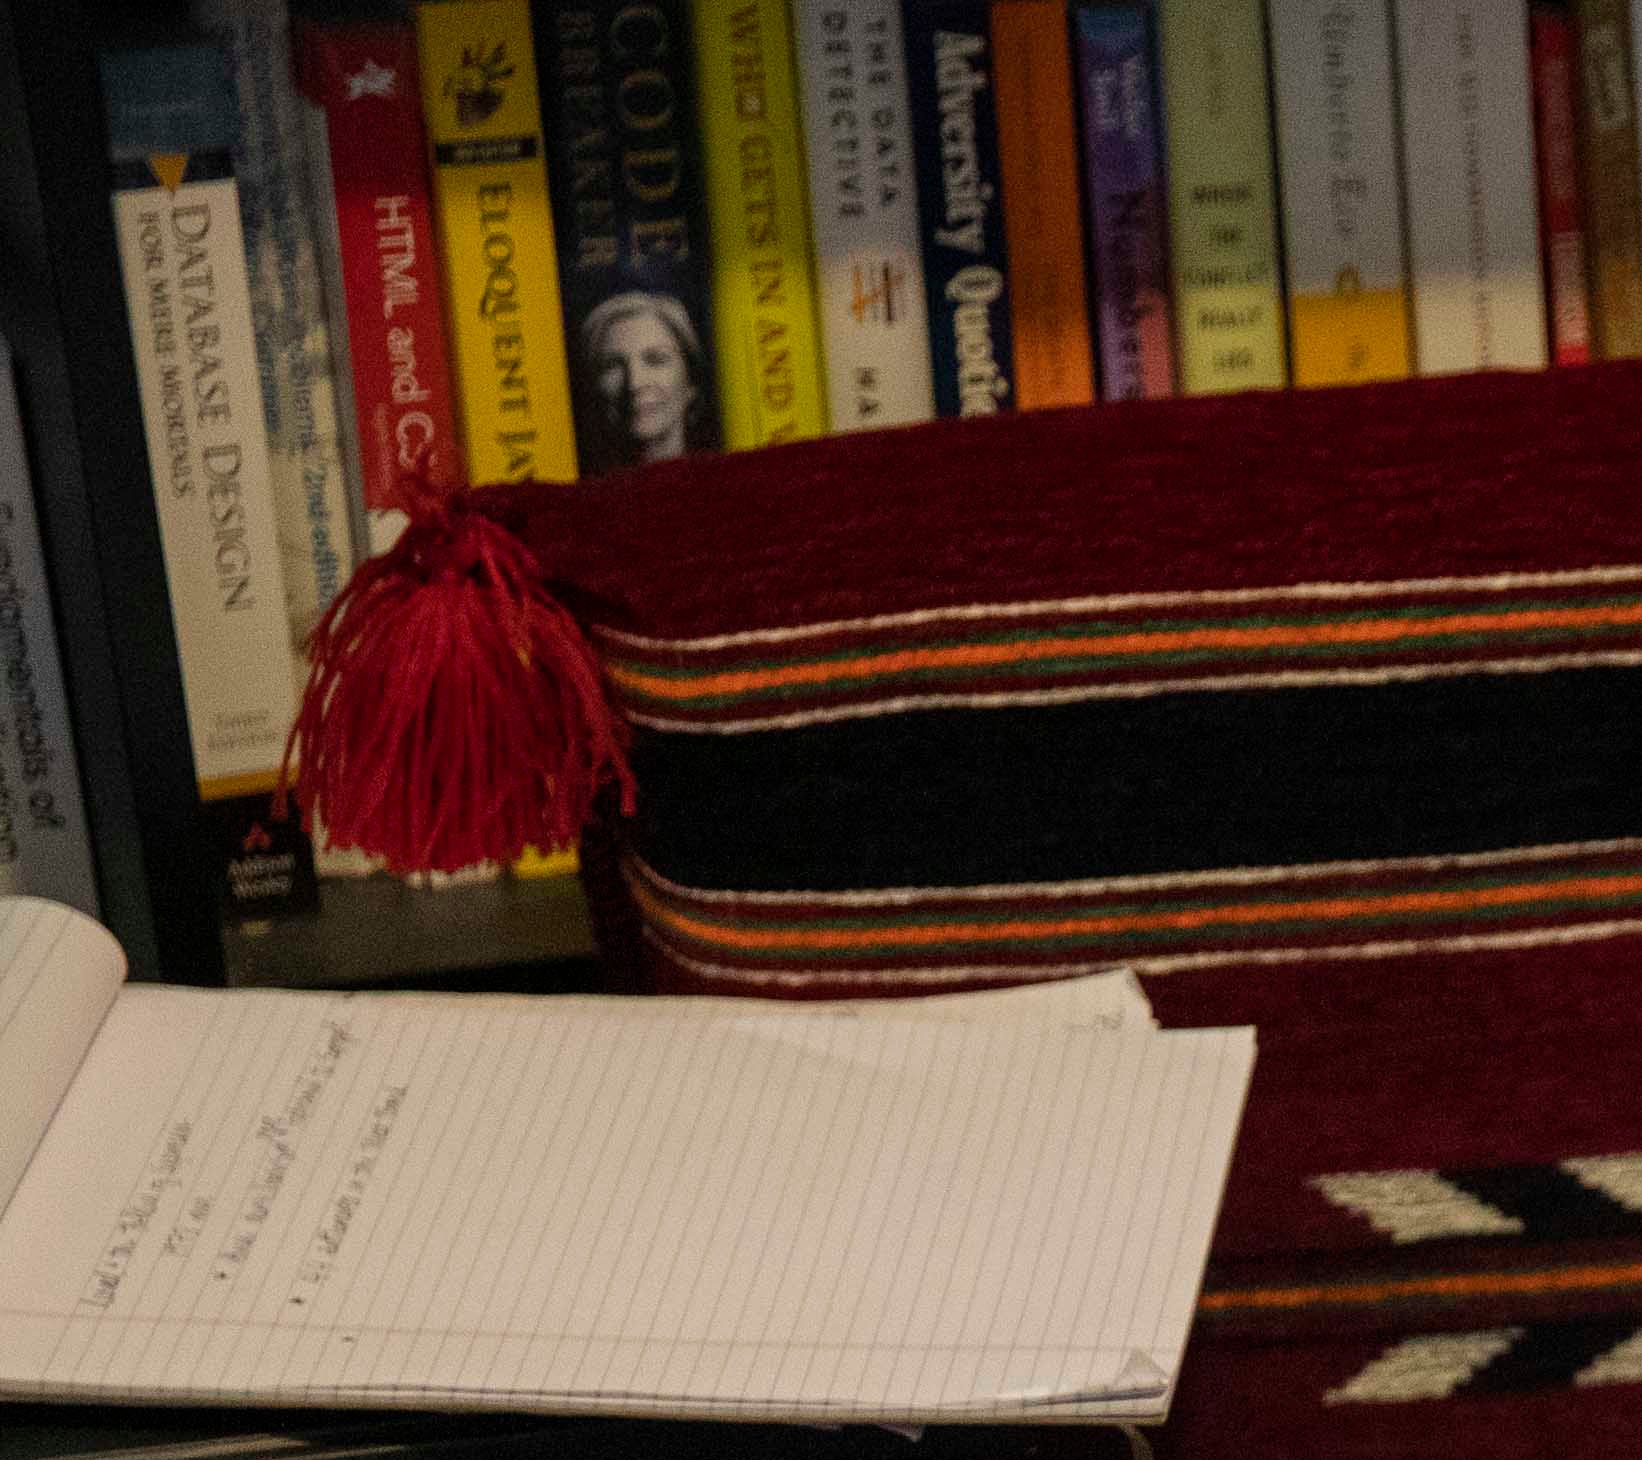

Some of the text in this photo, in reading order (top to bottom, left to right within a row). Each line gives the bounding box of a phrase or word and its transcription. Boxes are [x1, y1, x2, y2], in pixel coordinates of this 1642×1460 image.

[555, 8, 622, 270] BREAKER
[607, 2, 691, 270] CODE
[739, 133, 778, 249] GETS
[822, 10, 865, 219] DETECTIVE
[866, 18, 897, 208] THE DATA
[932, 29, 996, 254] Adversity
[138, 210, 195, 499] FOR MERE MORTALS
[373, 193, 422, 320] HTML
[479, 181, 531, 415] ELOQUENT
[750, 256, 784, 309] IN
[170, 202, 255, 613] DATABASE DESIGN
[385, 325, 433, 405] and
[758, 318, 797, 412] AND
[31, 790, 67, 829] of
